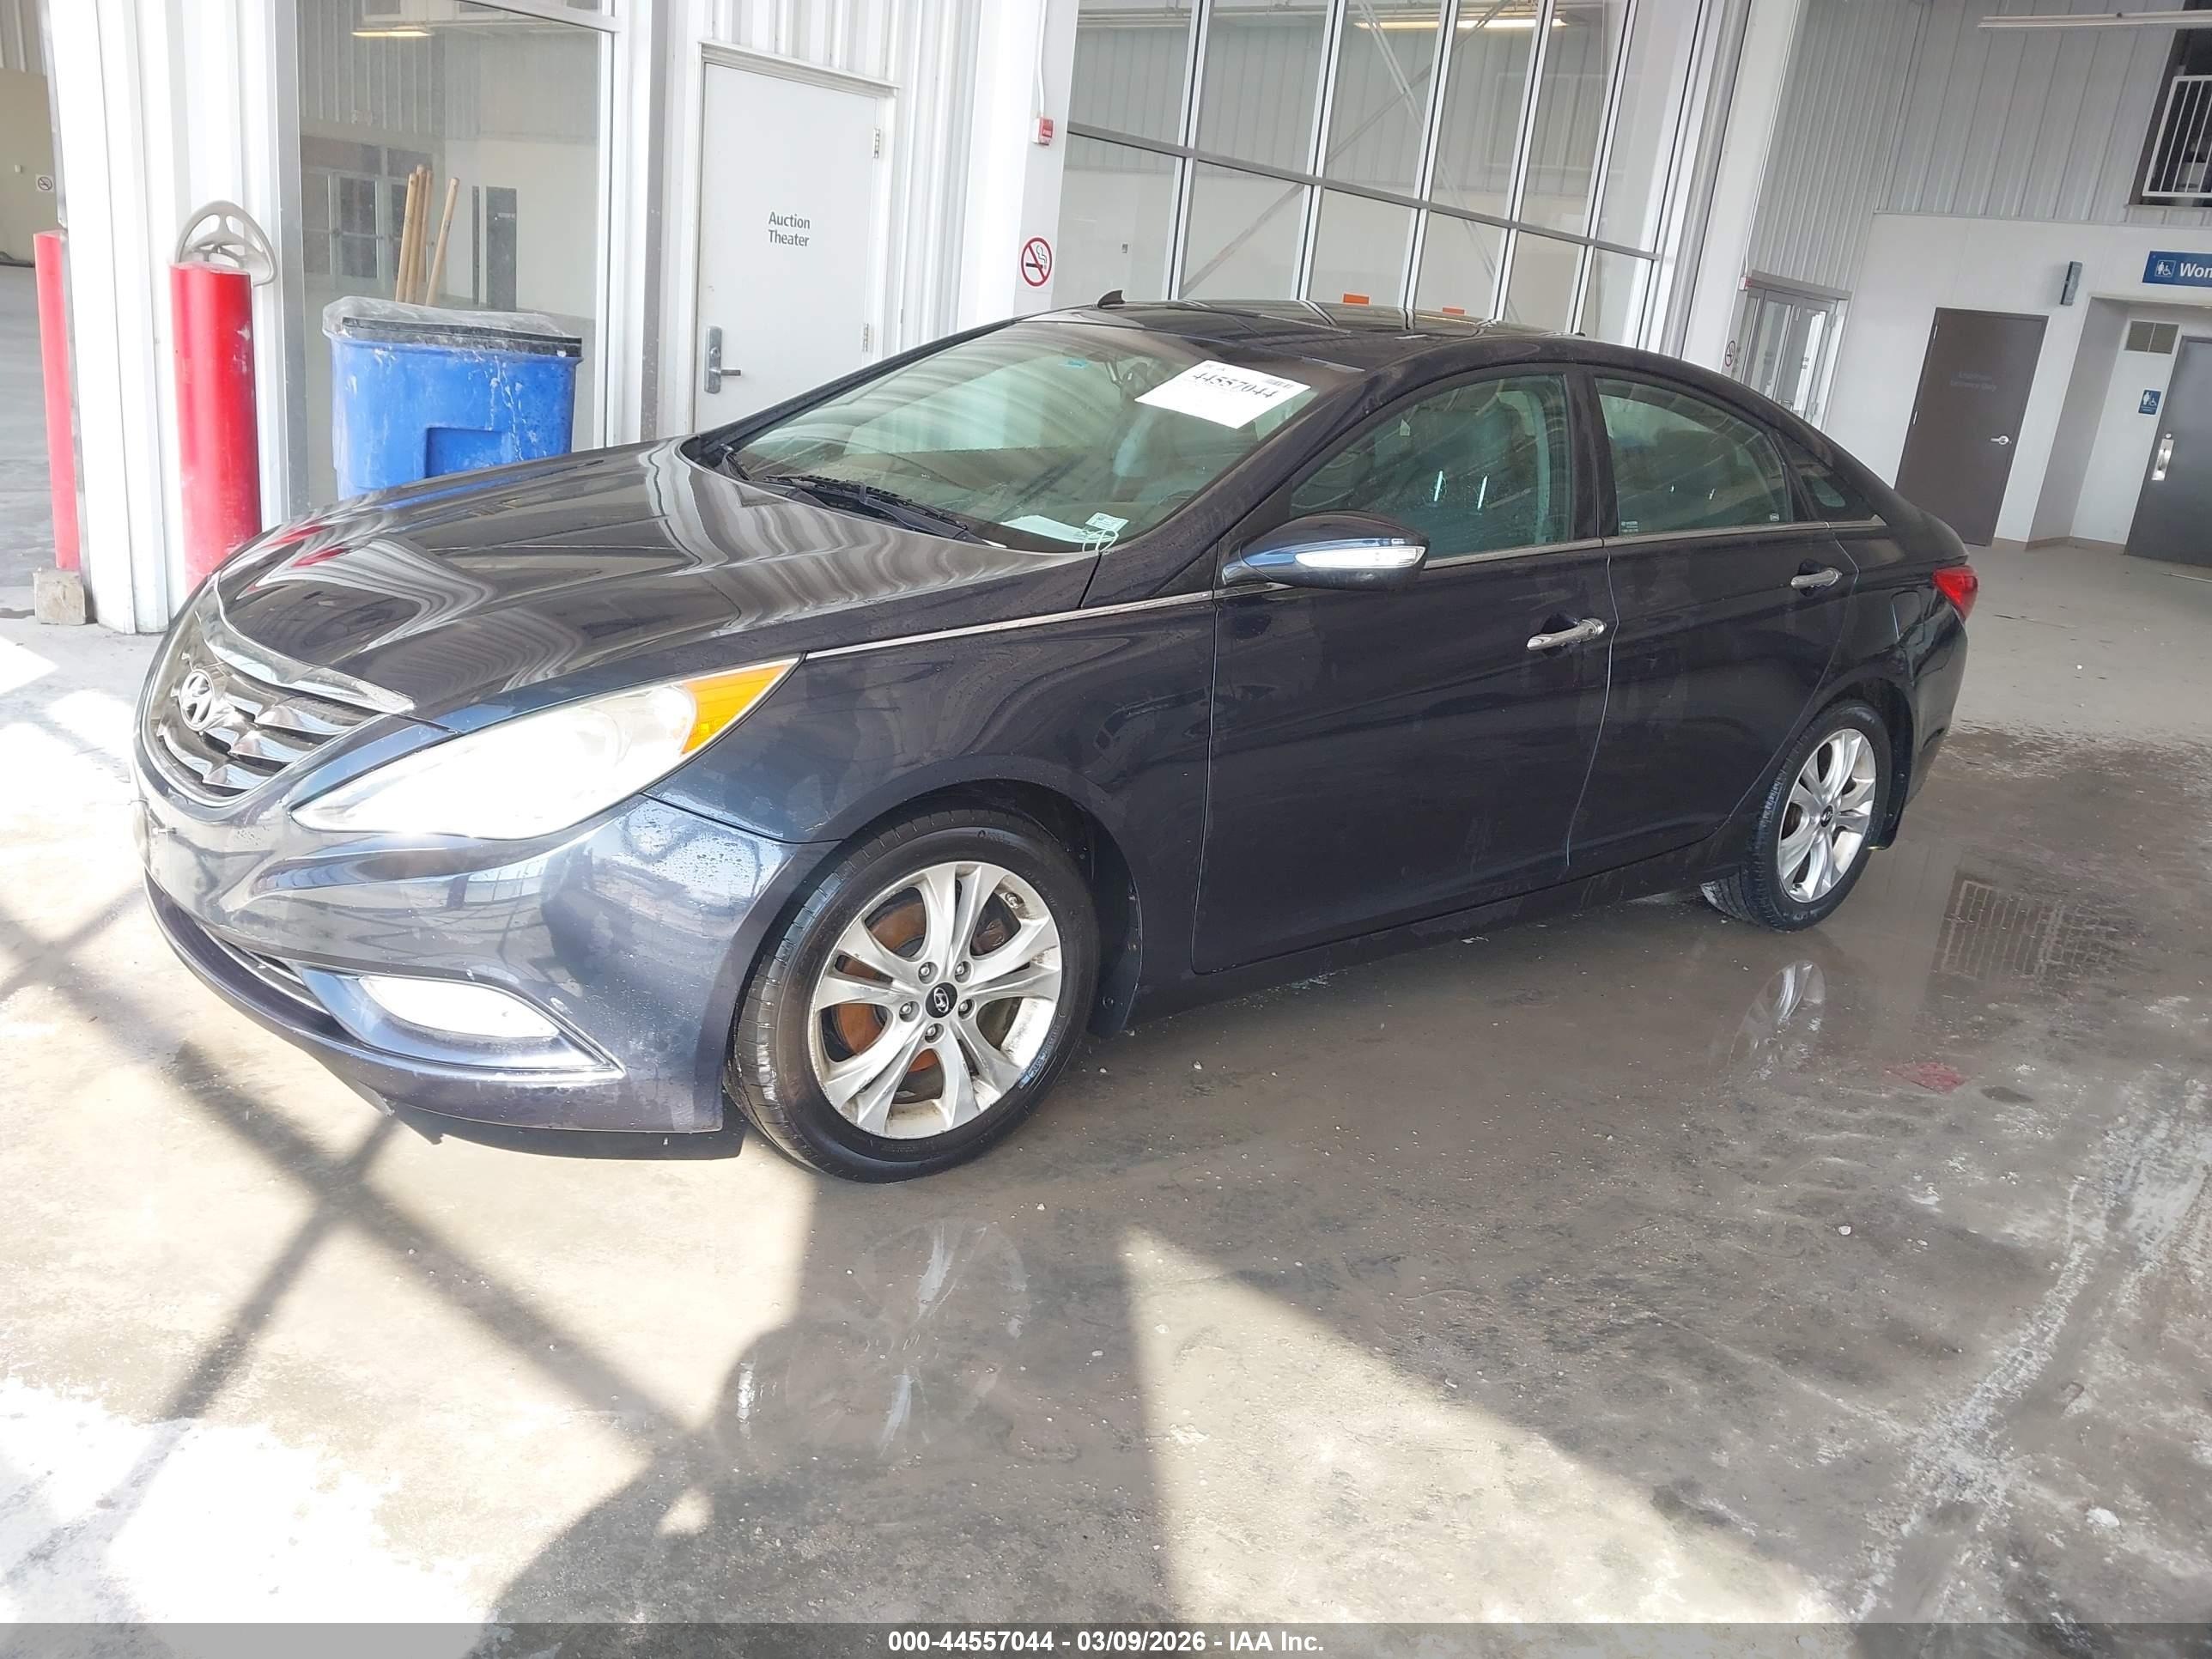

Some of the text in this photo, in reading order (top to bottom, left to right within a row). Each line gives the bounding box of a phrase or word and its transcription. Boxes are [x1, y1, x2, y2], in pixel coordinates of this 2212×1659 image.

[769, 211, 811, 229] Auction
[768, 228, 810, 247] Theater
[1193, 373, 1279, 398] 44557044
